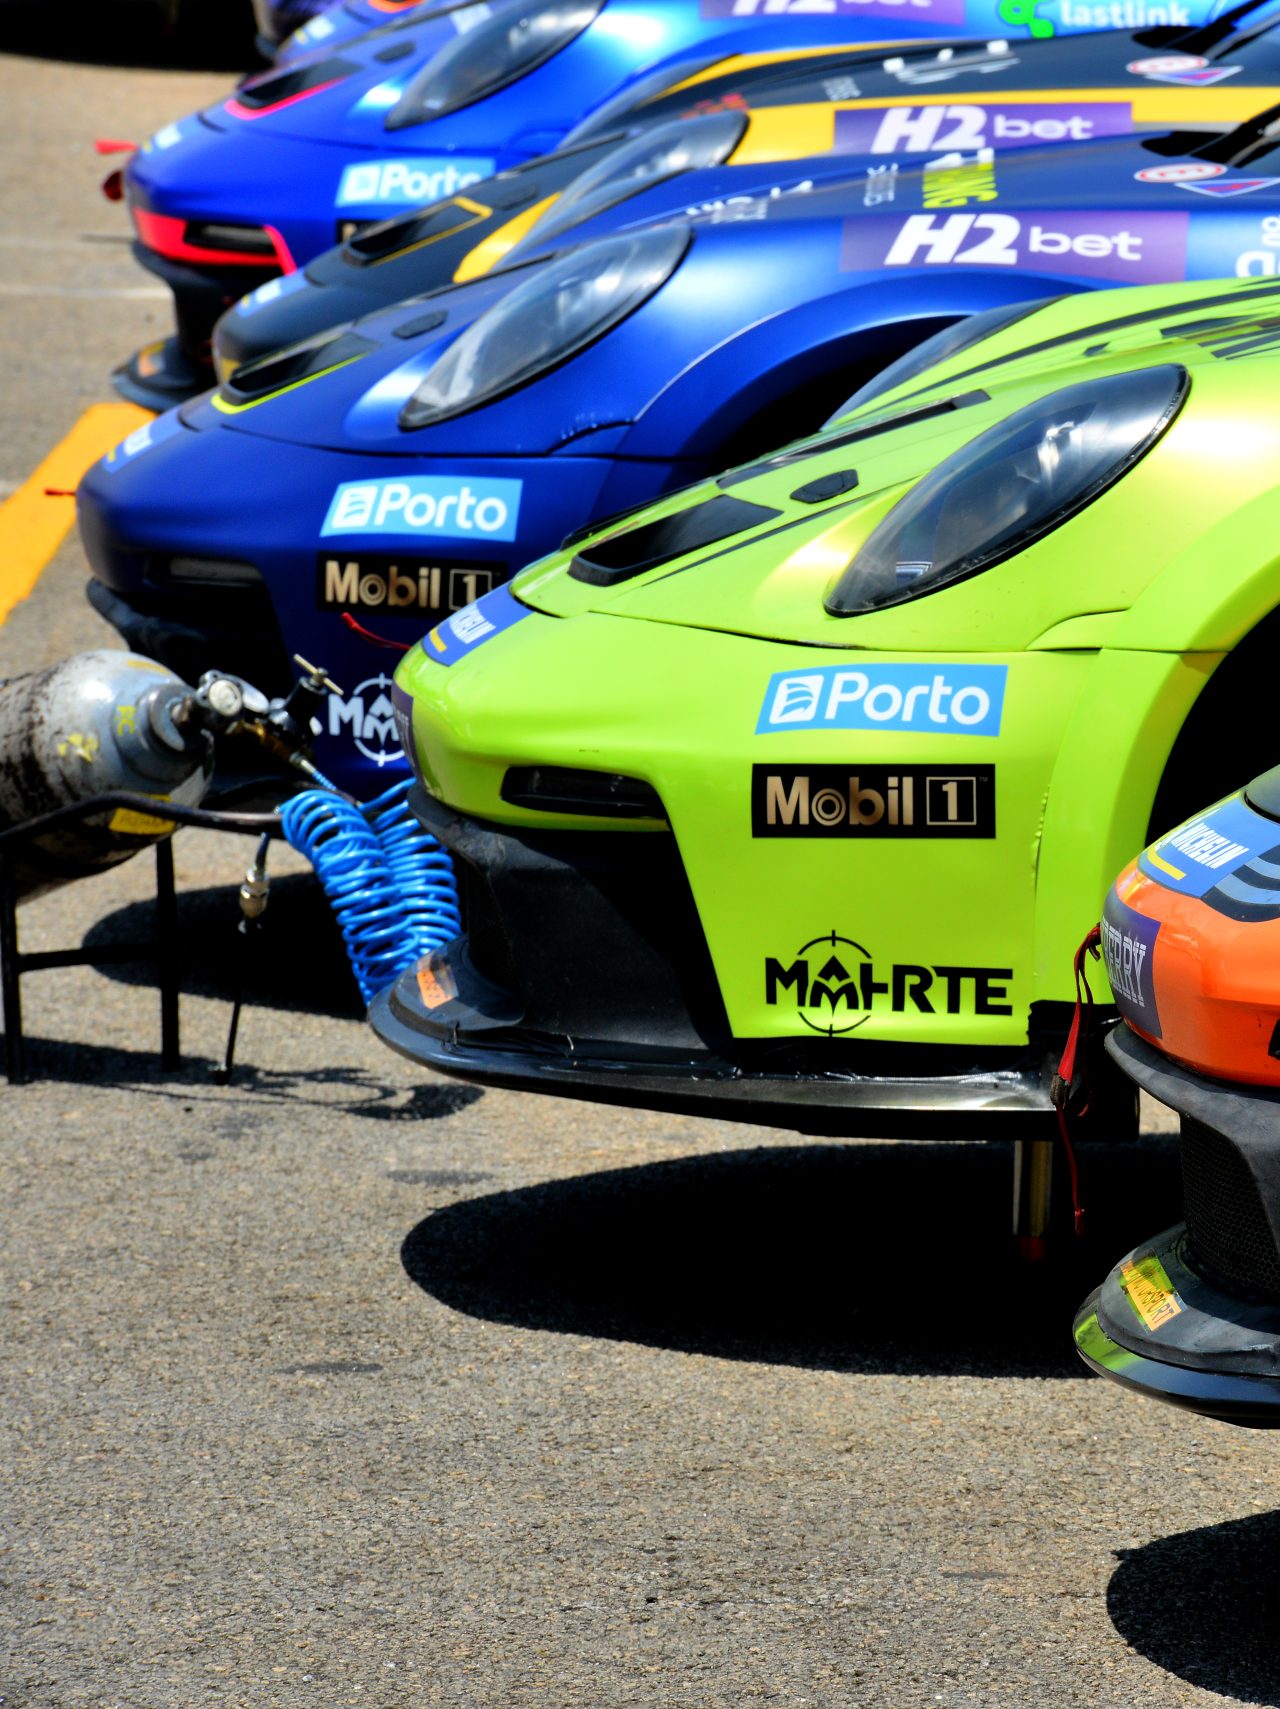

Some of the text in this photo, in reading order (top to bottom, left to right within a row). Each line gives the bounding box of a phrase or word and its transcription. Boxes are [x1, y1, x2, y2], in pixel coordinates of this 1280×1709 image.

[1060, 0, 1190, 28] lastlink
[871, 105, 1094, 154] H2 bet
[884, 213, 1143, 266] H2 bet
[374, 483, 508, 532] Porto
[325, 559, 441, 609] Mobil
[824, 671, 990, 726] Porto
[766, 776, 914, 826] Mobil
[942, 781, 958, 821] 1
